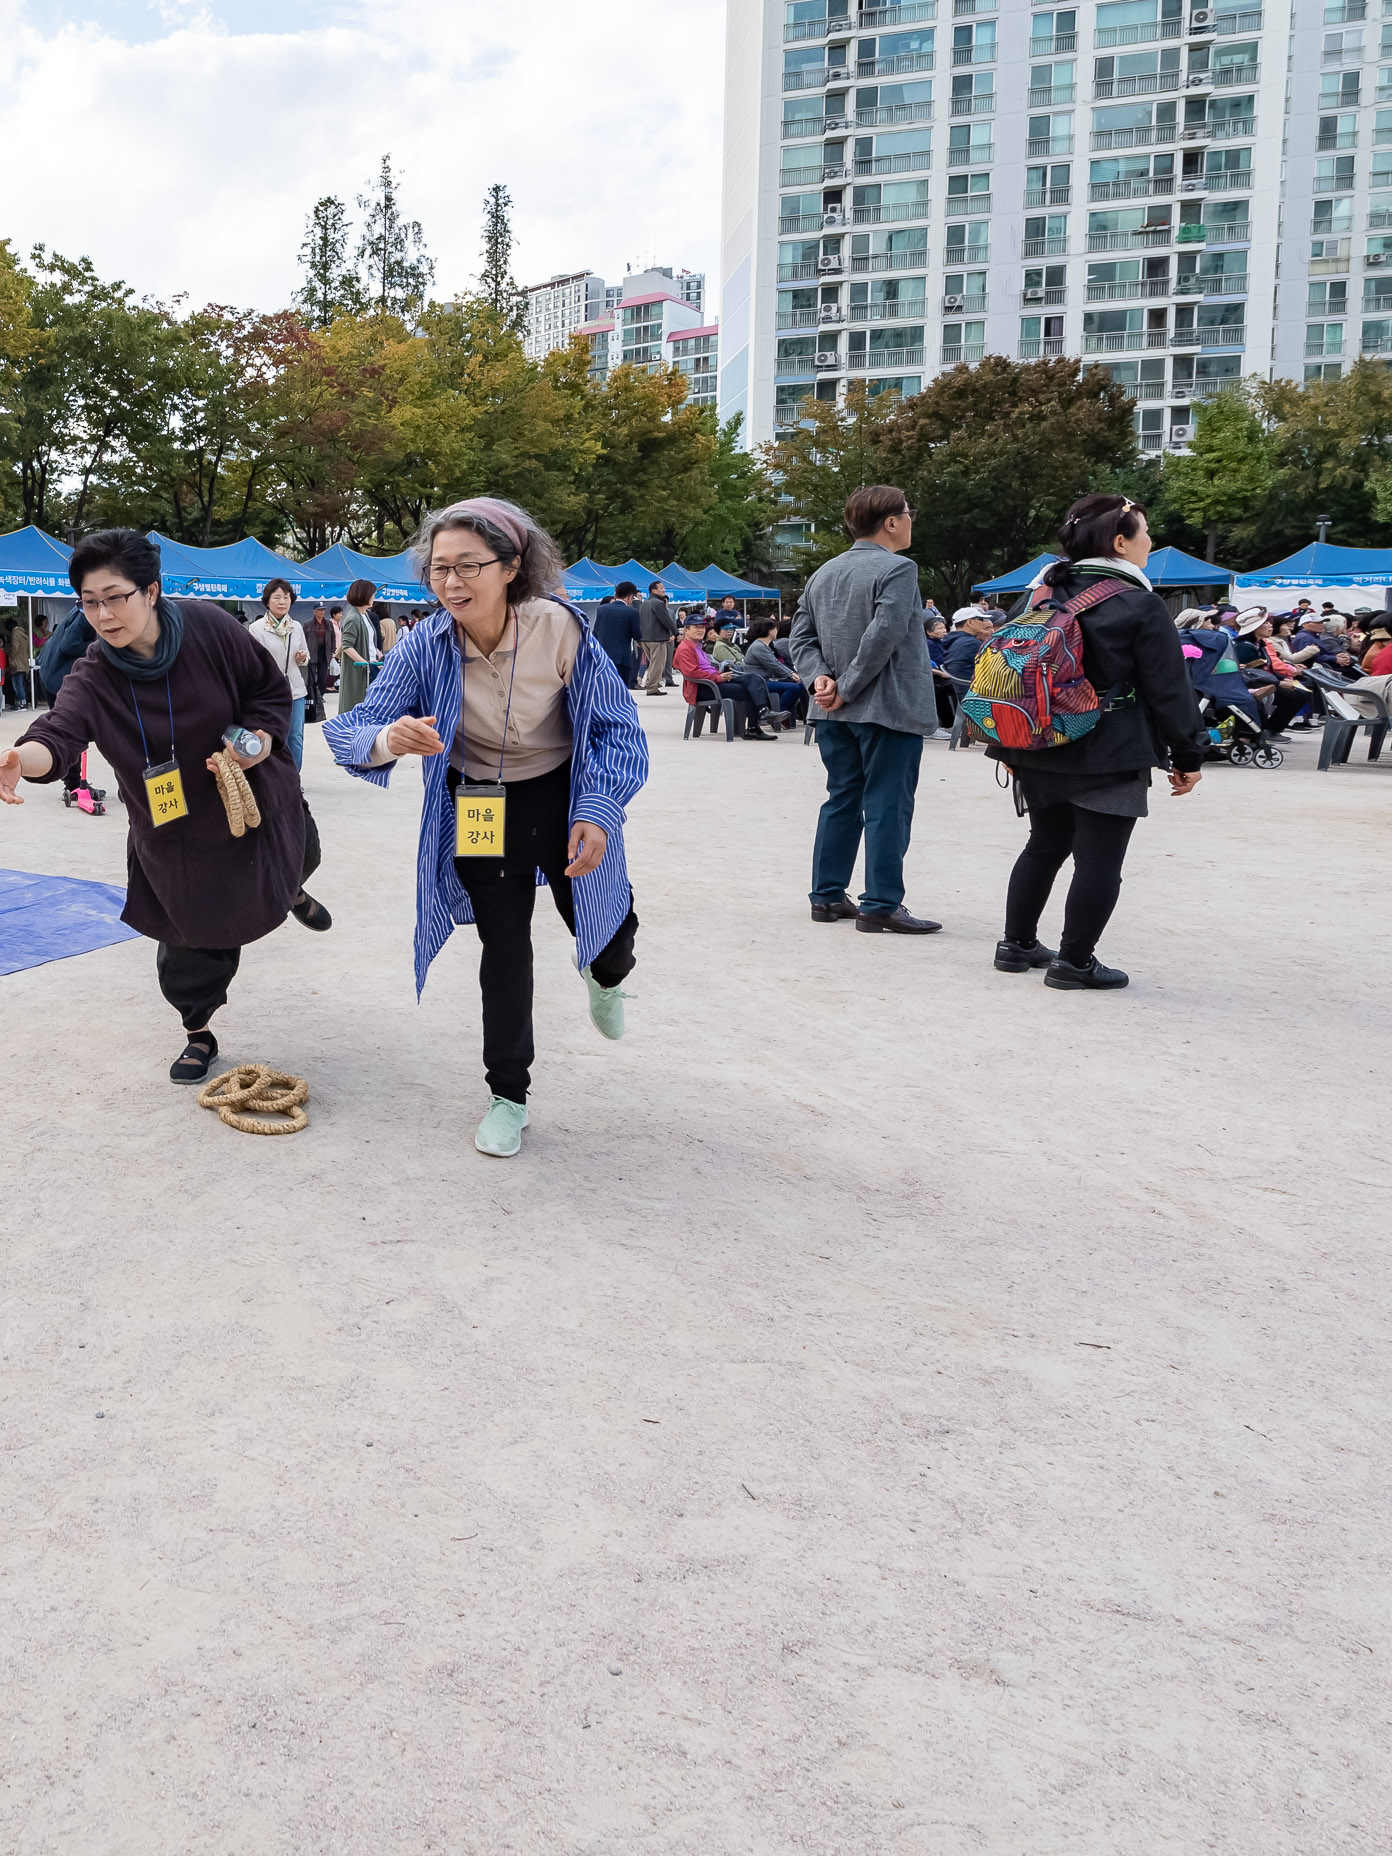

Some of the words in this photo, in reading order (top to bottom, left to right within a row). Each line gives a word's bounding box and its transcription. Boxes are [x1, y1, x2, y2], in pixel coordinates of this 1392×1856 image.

[154, 781, 175, 795] 마을
[158, 798, 178, 814] 강사
[467, 808, 495, 822] 마을
[467, 830, 496, 844] 강사
